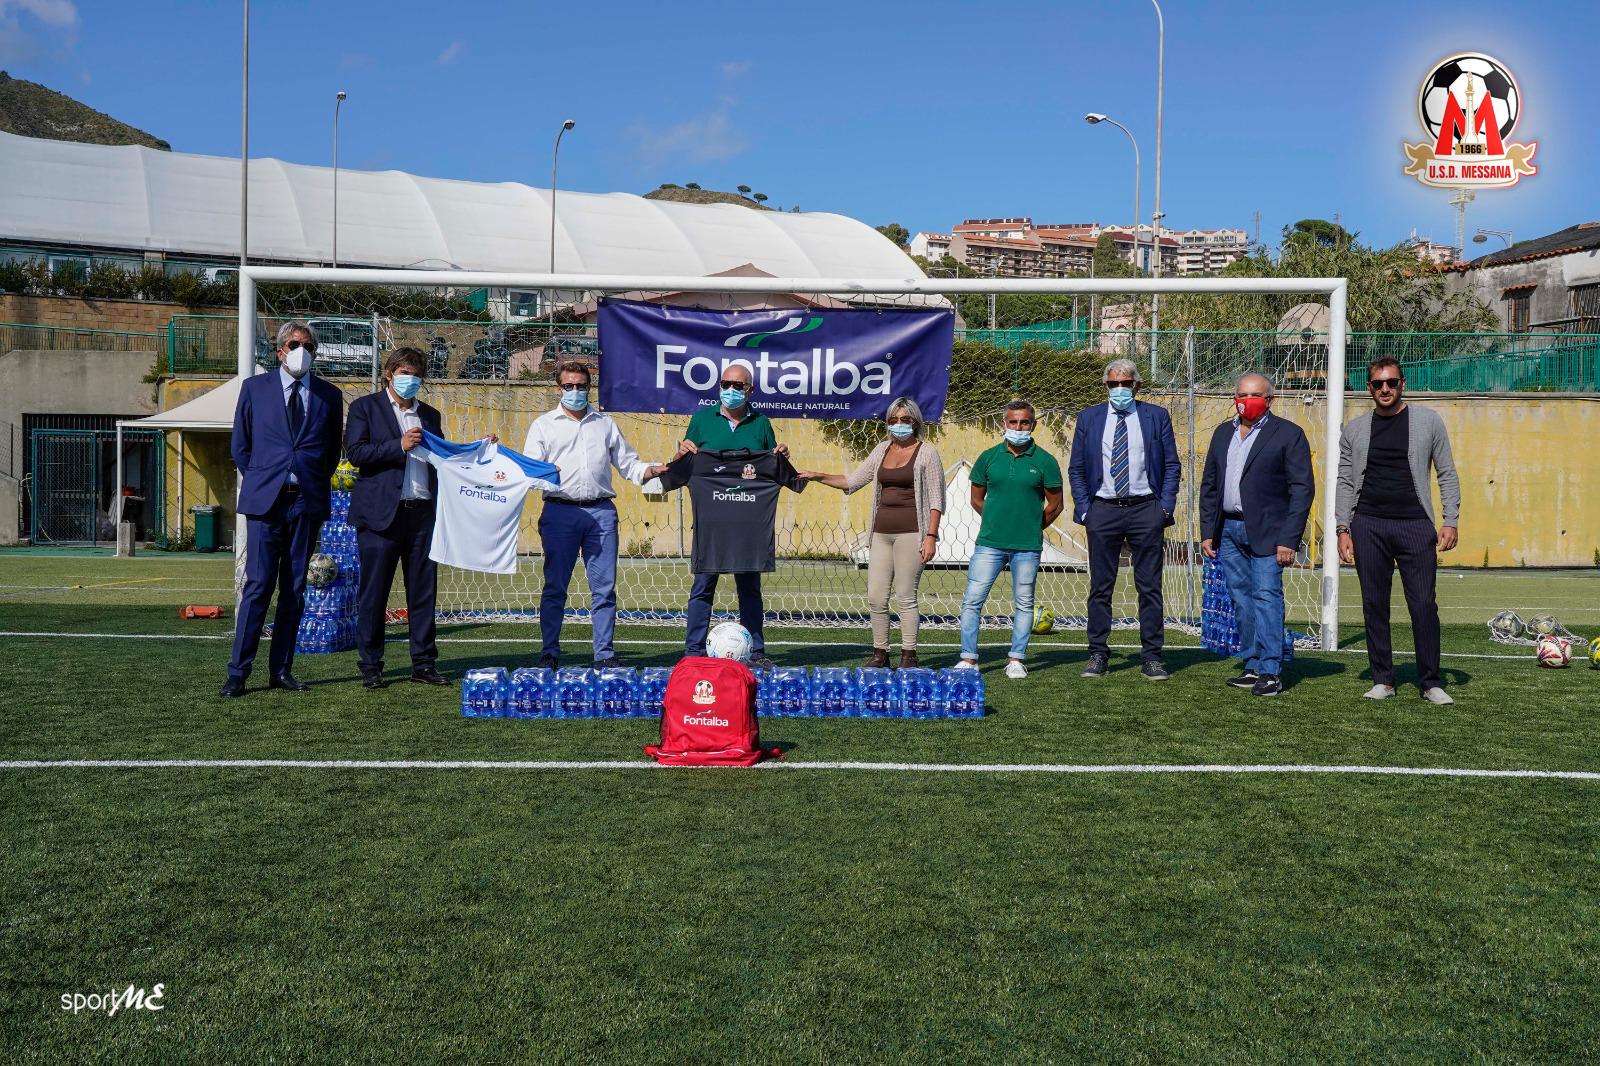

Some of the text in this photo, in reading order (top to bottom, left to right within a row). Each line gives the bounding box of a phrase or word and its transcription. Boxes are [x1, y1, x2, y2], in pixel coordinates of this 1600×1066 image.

[749, 401, 803, 410] OMINERALE
[804, 402, 850, 410] NATURALE
[459, 485, 507, 503] Fontalba
[712, 490, 756, 502] Fontalba
[683, 715, 729, 727] Fontalba
